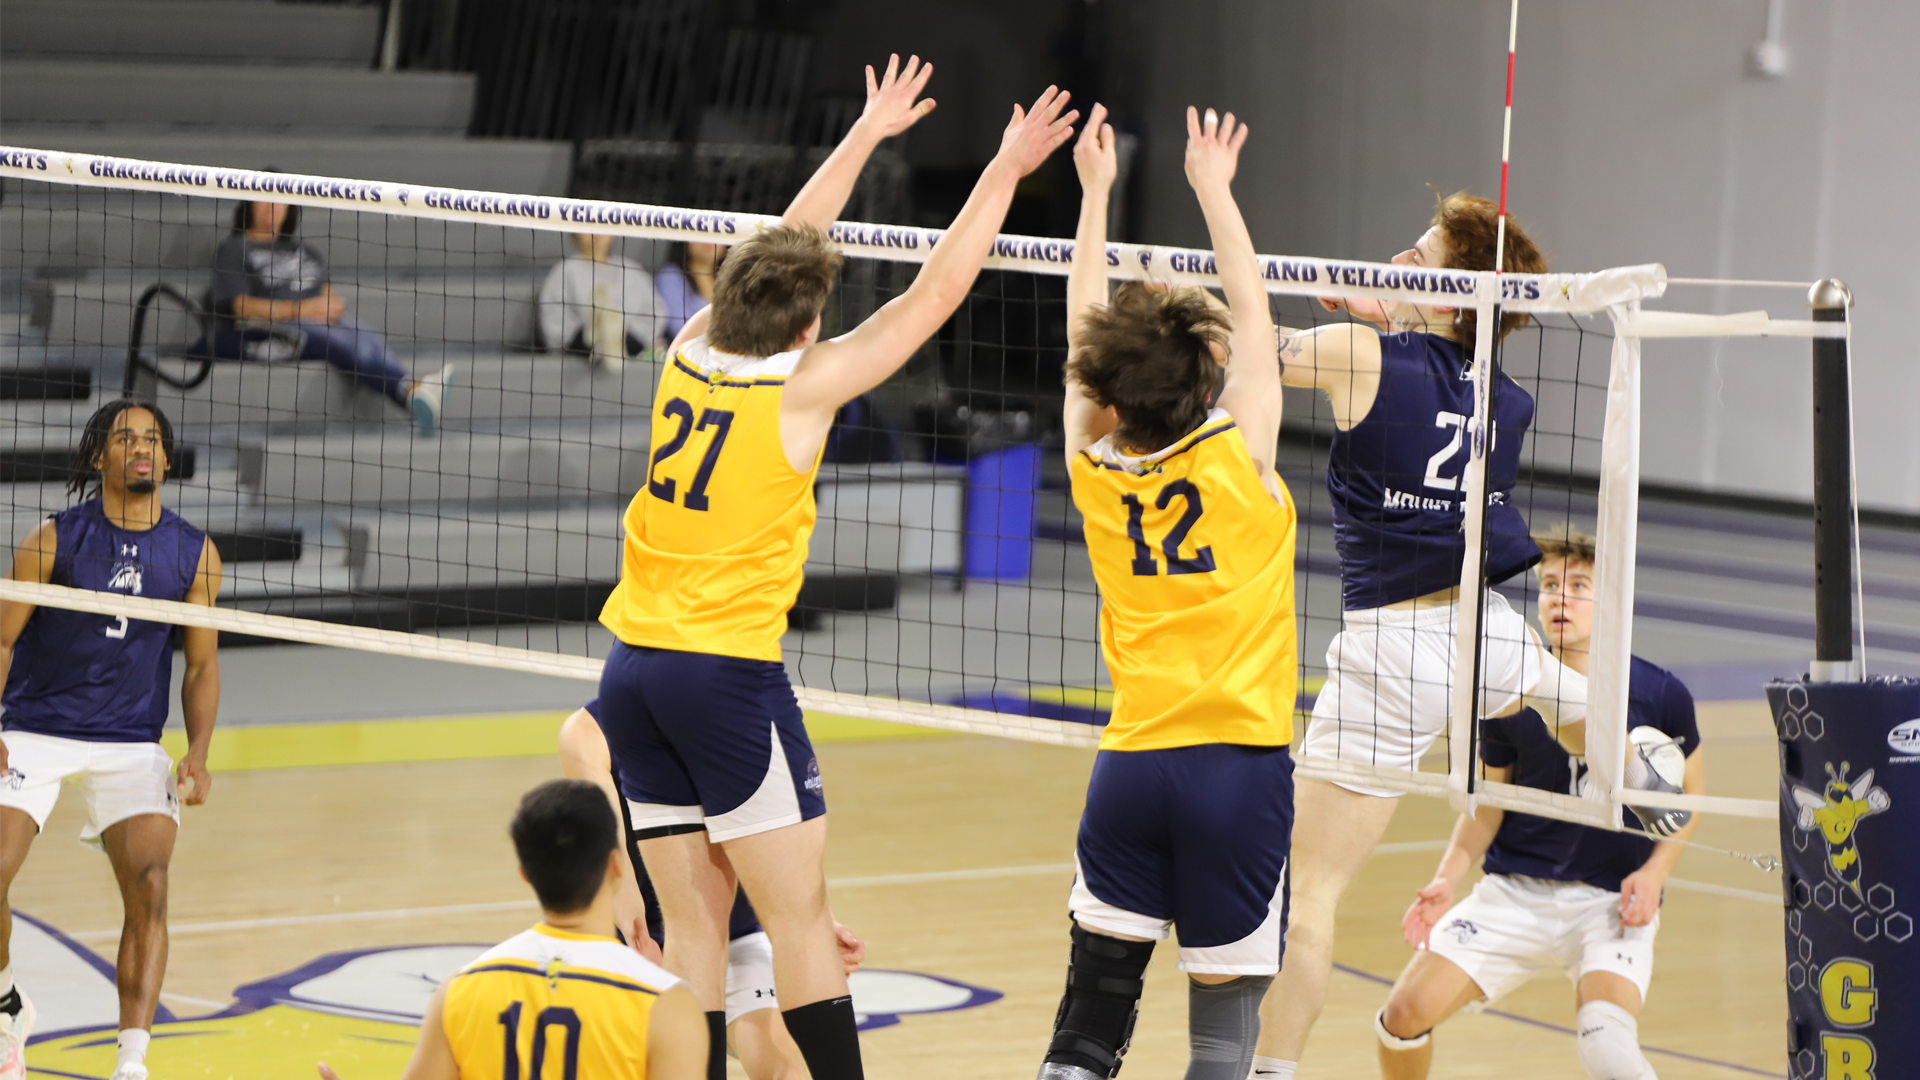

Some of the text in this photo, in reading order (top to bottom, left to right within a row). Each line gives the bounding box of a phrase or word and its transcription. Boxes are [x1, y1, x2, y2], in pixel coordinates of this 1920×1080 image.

[89, 159, 382, 203] GRACELAND YELLOWJACKETS
[424, 190, 737, 234] GRACELAND YELLOWJACKETS
[828, 224, 1120, 267] CELAND YWJACKS
[1170, 251, 1540, 300] GRAAND YELLOWJACTS
[648, 396, 735, 512] 27
[1121, 476, 1217, 576] 12
[498, 1000, 582, 1080] 10
